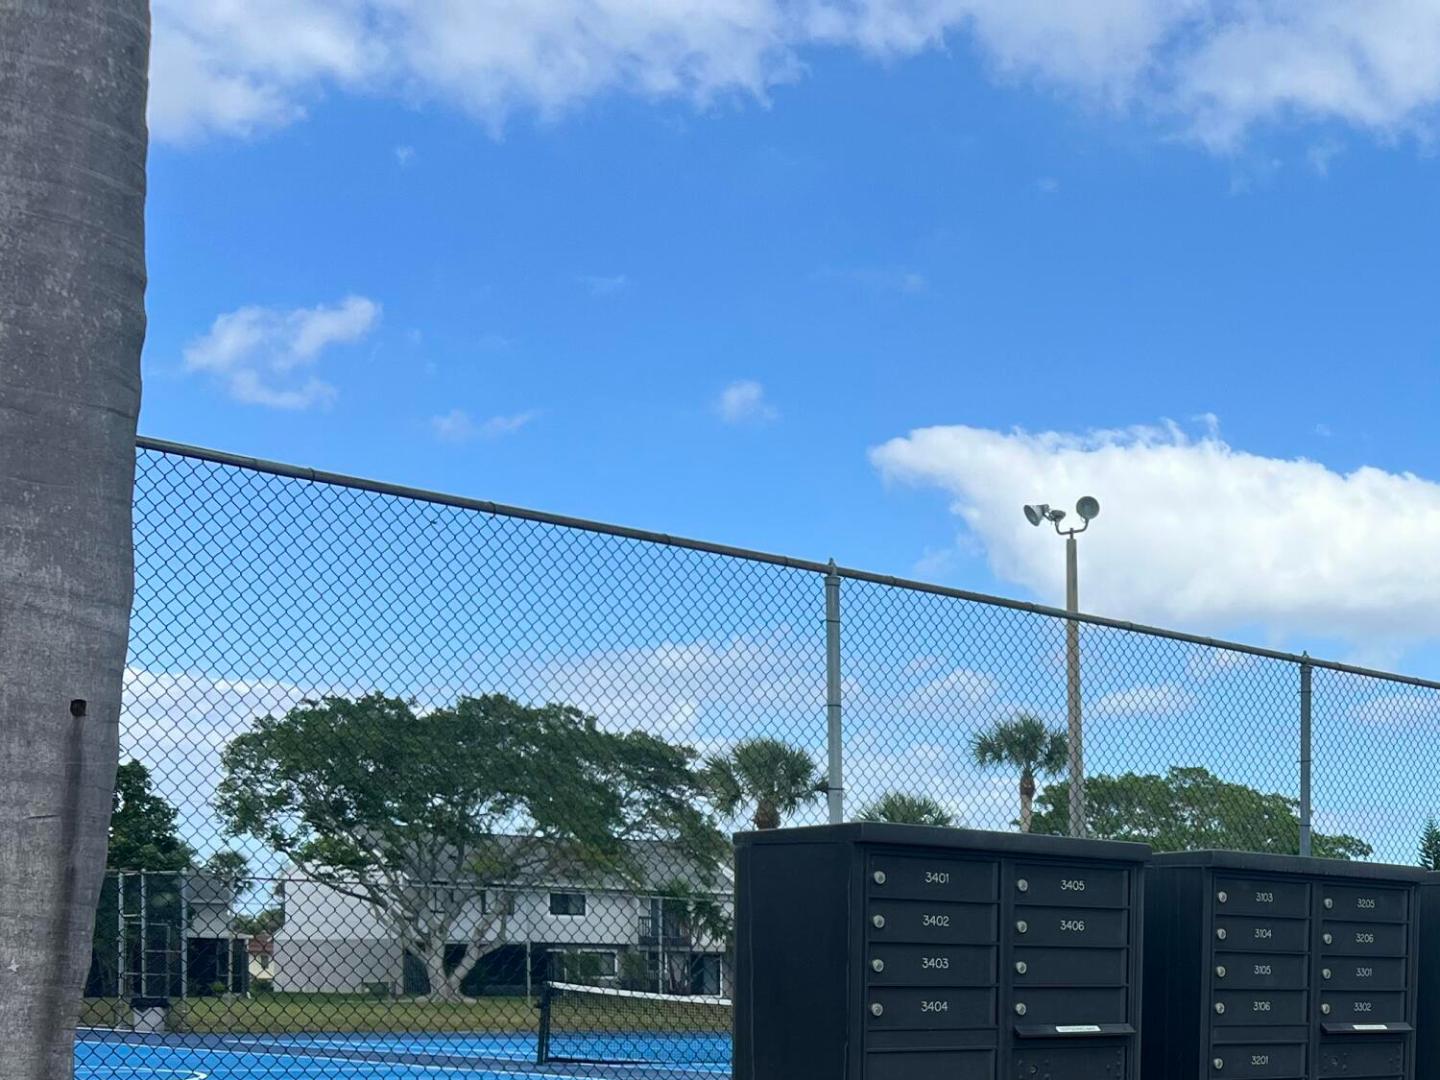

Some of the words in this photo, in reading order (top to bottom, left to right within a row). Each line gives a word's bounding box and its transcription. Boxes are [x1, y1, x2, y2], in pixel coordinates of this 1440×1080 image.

[924, 871, 950, 884] 3401
[1060, 879, 1085, 892] 3405
[1255, 891, 1274, 903] 3103
[1356, 897, 1376, 909] 3205
[922, 914, 950, 927] 3402
[1059, 919, 1085, 932] 3406
[1254, 928, 1272, 939] 3104
[1355, 932, 1374, 944] 3206
[921, 957, 950, 969] 3403
[1253, 964, 1272, 976] 3105
[1355, 967, 1373, 978] 3301
[920, 1000, 949, 1013] 3404
[1252, 1001, 1271, 1012] 3106
[1353, 1001, 1372, 1012] 3302
[1250, 1055, 1269, 1066] 3201
